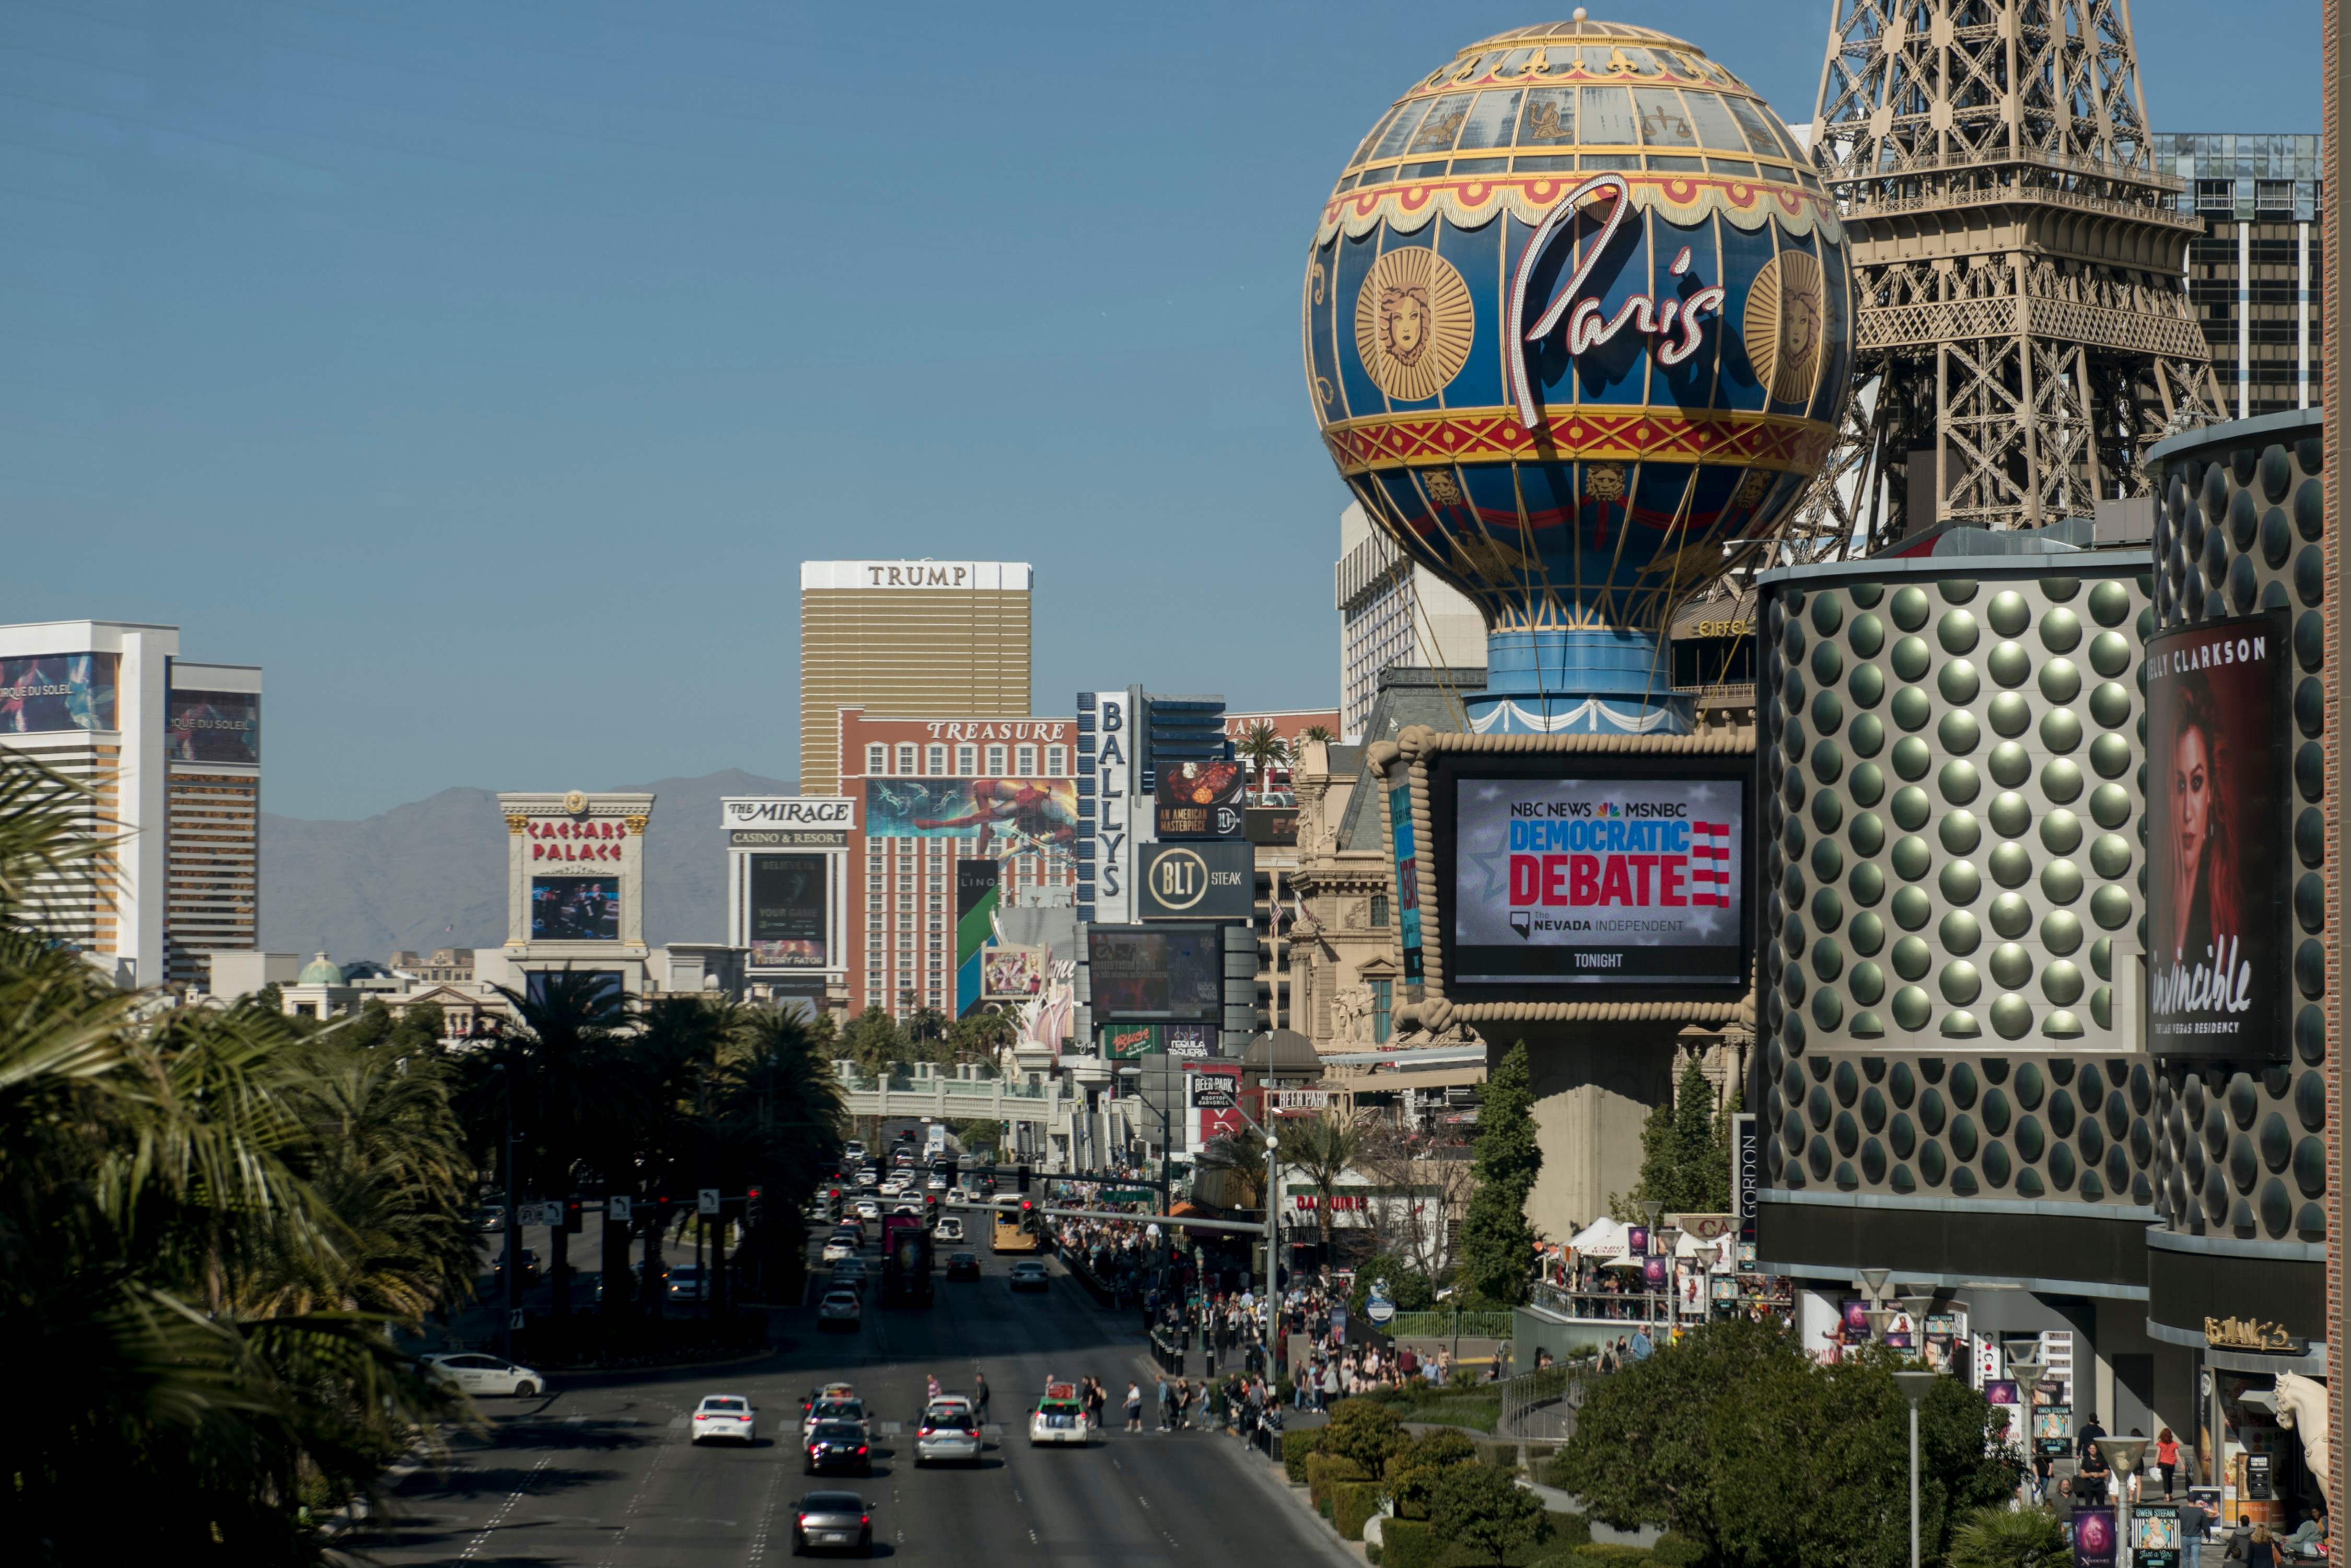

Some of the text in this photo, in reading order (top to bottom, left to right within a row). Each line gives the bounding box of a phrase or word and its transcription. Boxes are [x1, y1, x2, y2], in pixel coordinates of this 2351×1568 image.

[1508, 172, 1725, 429] Paris
[868, 566, 967, 586] TRUMP
[2174, 636, 2265, 673] CLARKSON
[28, 686, 41, 696] DU
[42, 684, 75, 695] SOLEIL
[198, 719, 213, 728] DU
[214, 720, 251, 730] SOLEIL
[927, 722, 1065, 742] TREASURE
[1099, 702, 1125, 897] BALLYS
[729, 803, 849, 823] THE MIRAGE
[1160, 809, 1207, 820] AN AMERICAN
[1511, 803, 1687, 817] NBC NEWS MSNBC
[527, 822, 627, 840] CAESARS
[1160, 820, 1206, 832] MASTERPIECE
[732, 833, 845, 843] CASINO & RESORT
[1510, 820, 1690, 851] DEMOCRATIC
[532, 843, 622, 861] PALACE
[961, 878, 995, 887] LINQ
[1162, 862, 1195, 895] BLT
[1211, 872, 1242, 885] STEAK
[1509, 855, 1687, 906] DEBATE
[759, 909, 786, 917] YOUR
[1534, 920, 1684, 932] NEVADA INDEPENDENT
[1574, 953, 1623, 967] TONIGHT
[2153, 934, 2252, 1015] invincible
[2172, 1023, 2192, 1034] VEGAS
[2194, 1021, 2240, 1034] RESIDENCY
[1171, 1040, 1205, 1049] TEQUILA
[1167, 1048, 1208, 1057] TAQUERIA
[1195, 1077, 1233, 1093] BEER PARK
[1279, 1090, 1330, 1109] BEER PARK
[1742, 1135, 1756, 1218] GORDON
[1297, 1195, 1368, 1212] DAIUIRIS
[2136, 1508, 2176, 1517] GWEN STEFANI
[2139, 1551, 2153, 1560] Just
